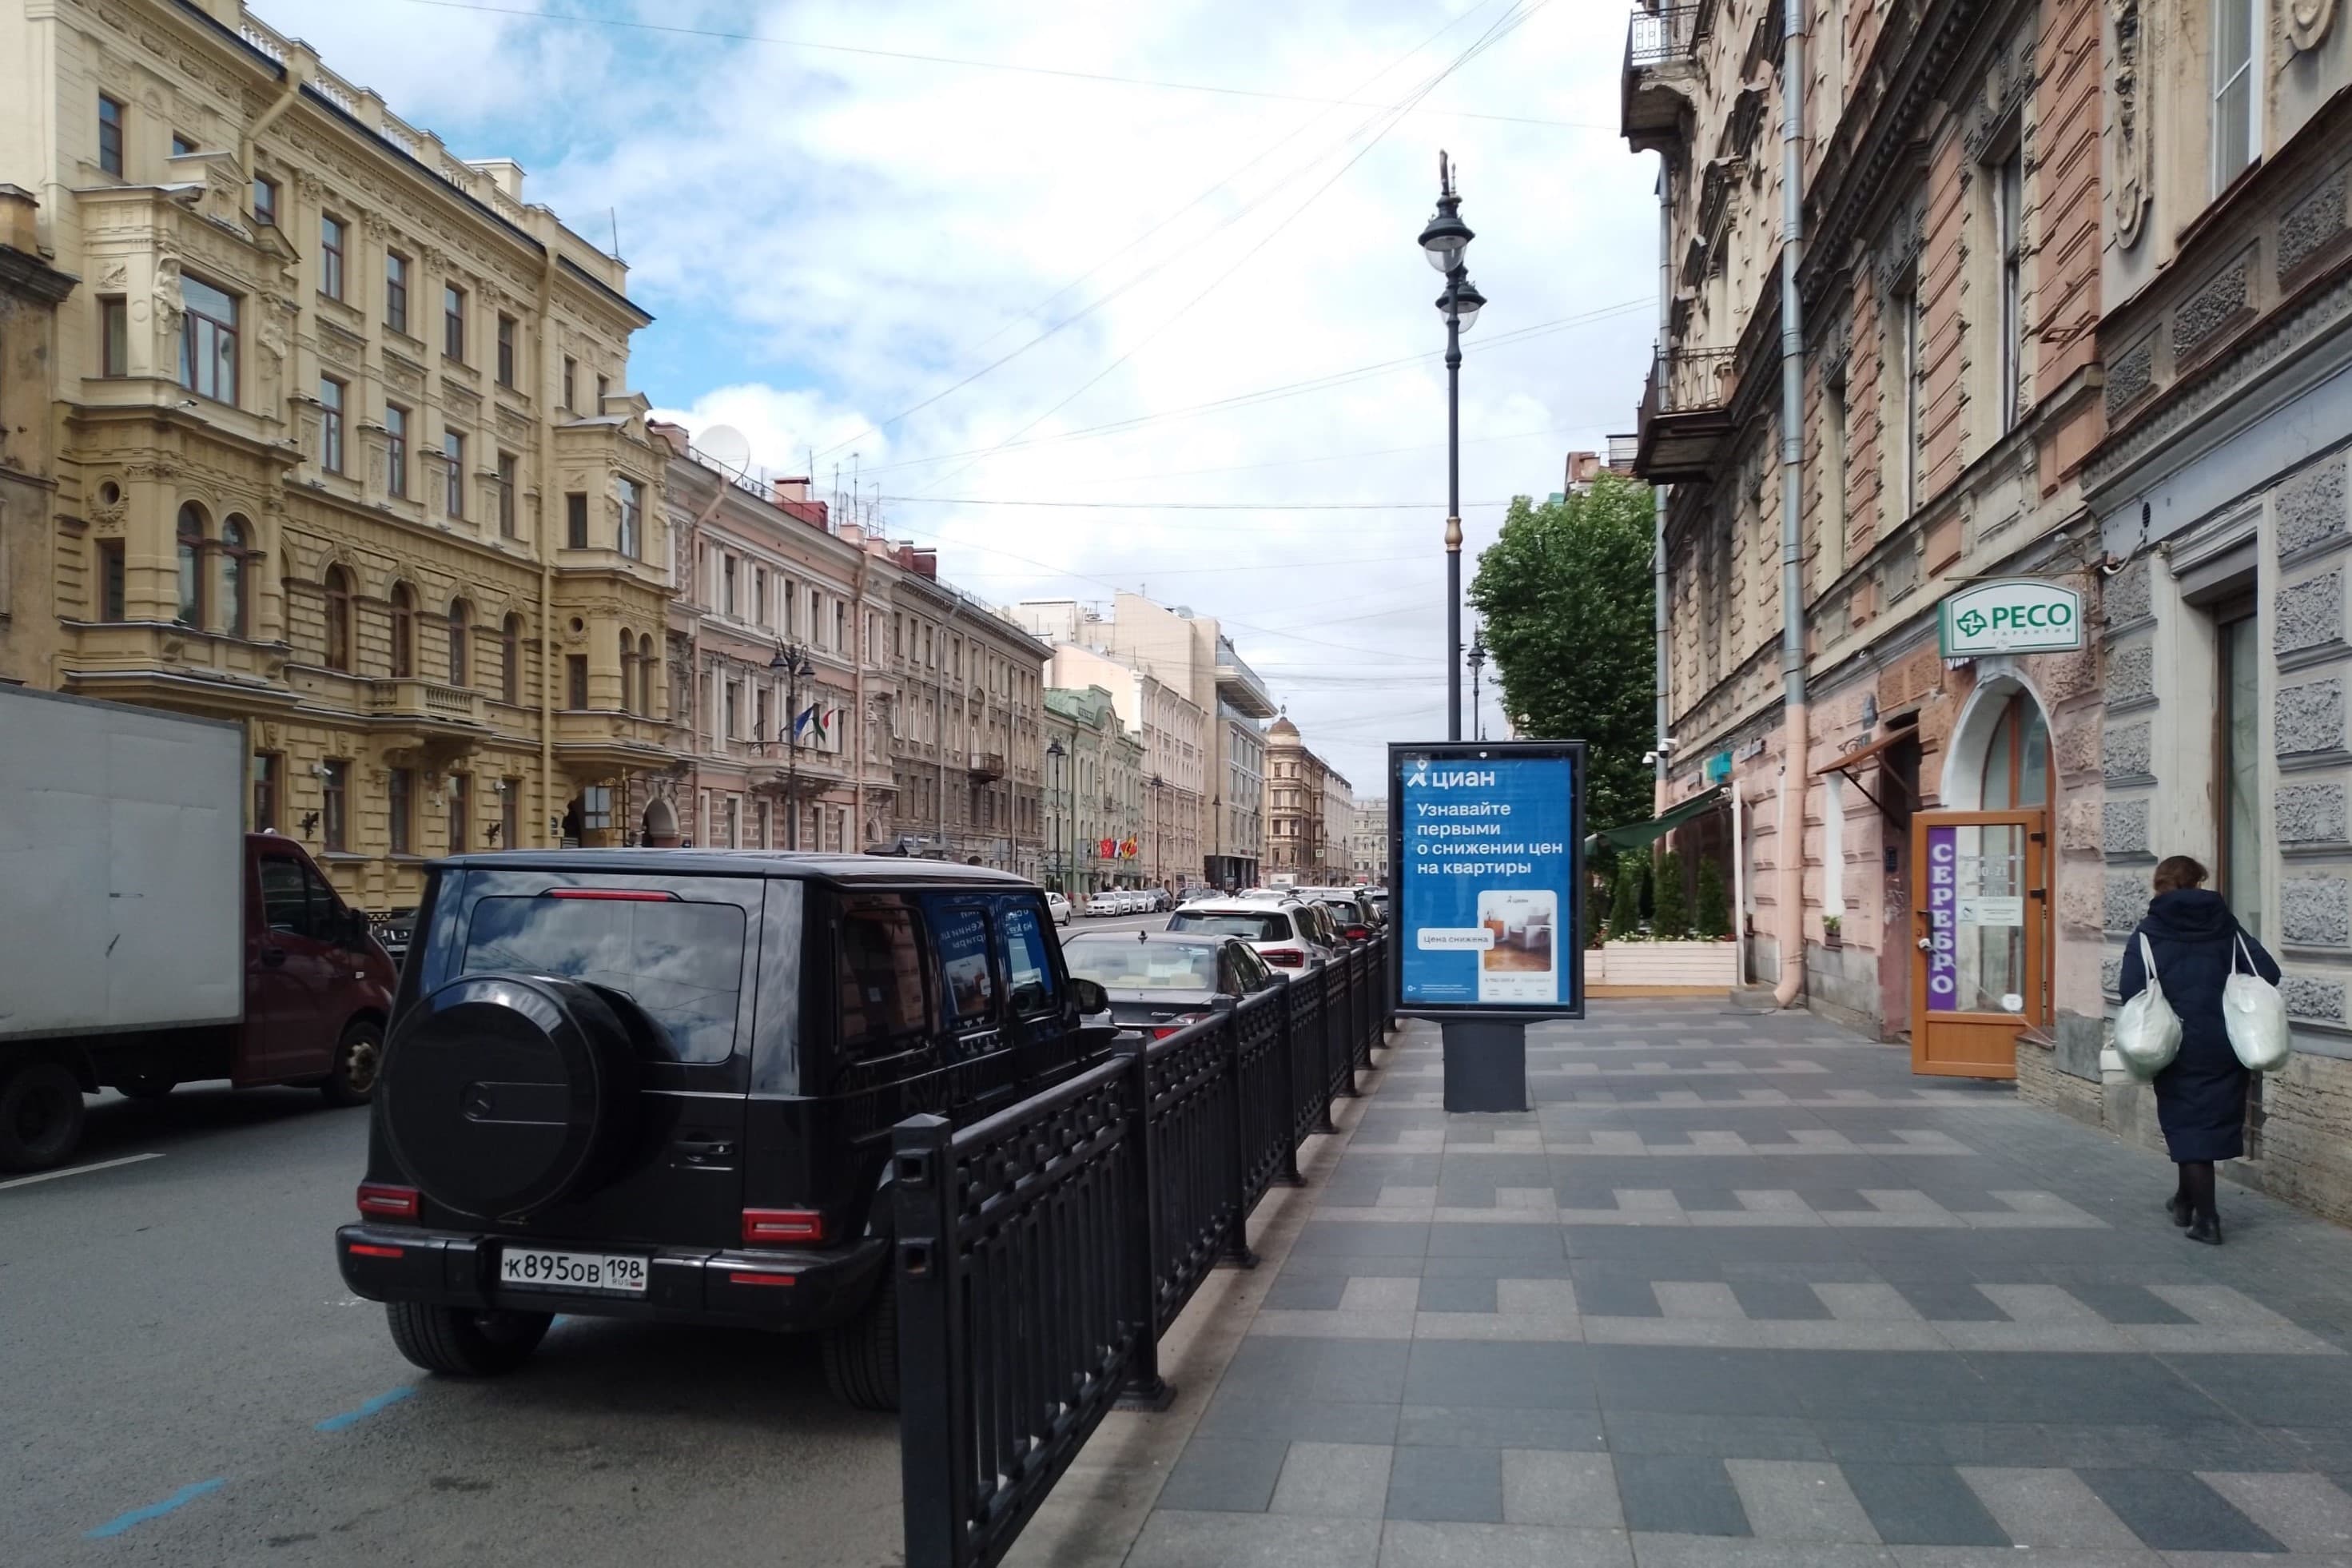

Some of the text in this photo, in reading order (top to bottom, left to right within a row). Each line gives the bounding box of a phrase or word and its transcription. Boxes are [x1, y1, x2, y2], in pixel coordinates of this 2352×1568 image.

[1992, 603, 2072, 629] РЕСО
[1432, 770, 1495, 790] циан
[1416, 802, 1511, 817] Узнавайте
[1417, 824, 1501, 838] первыми
[1416, 842, 1563, 857] о снижении цен
[1417, 862, 1531, 877] на квартиры
[606, 1259, 641, 1279] 198
